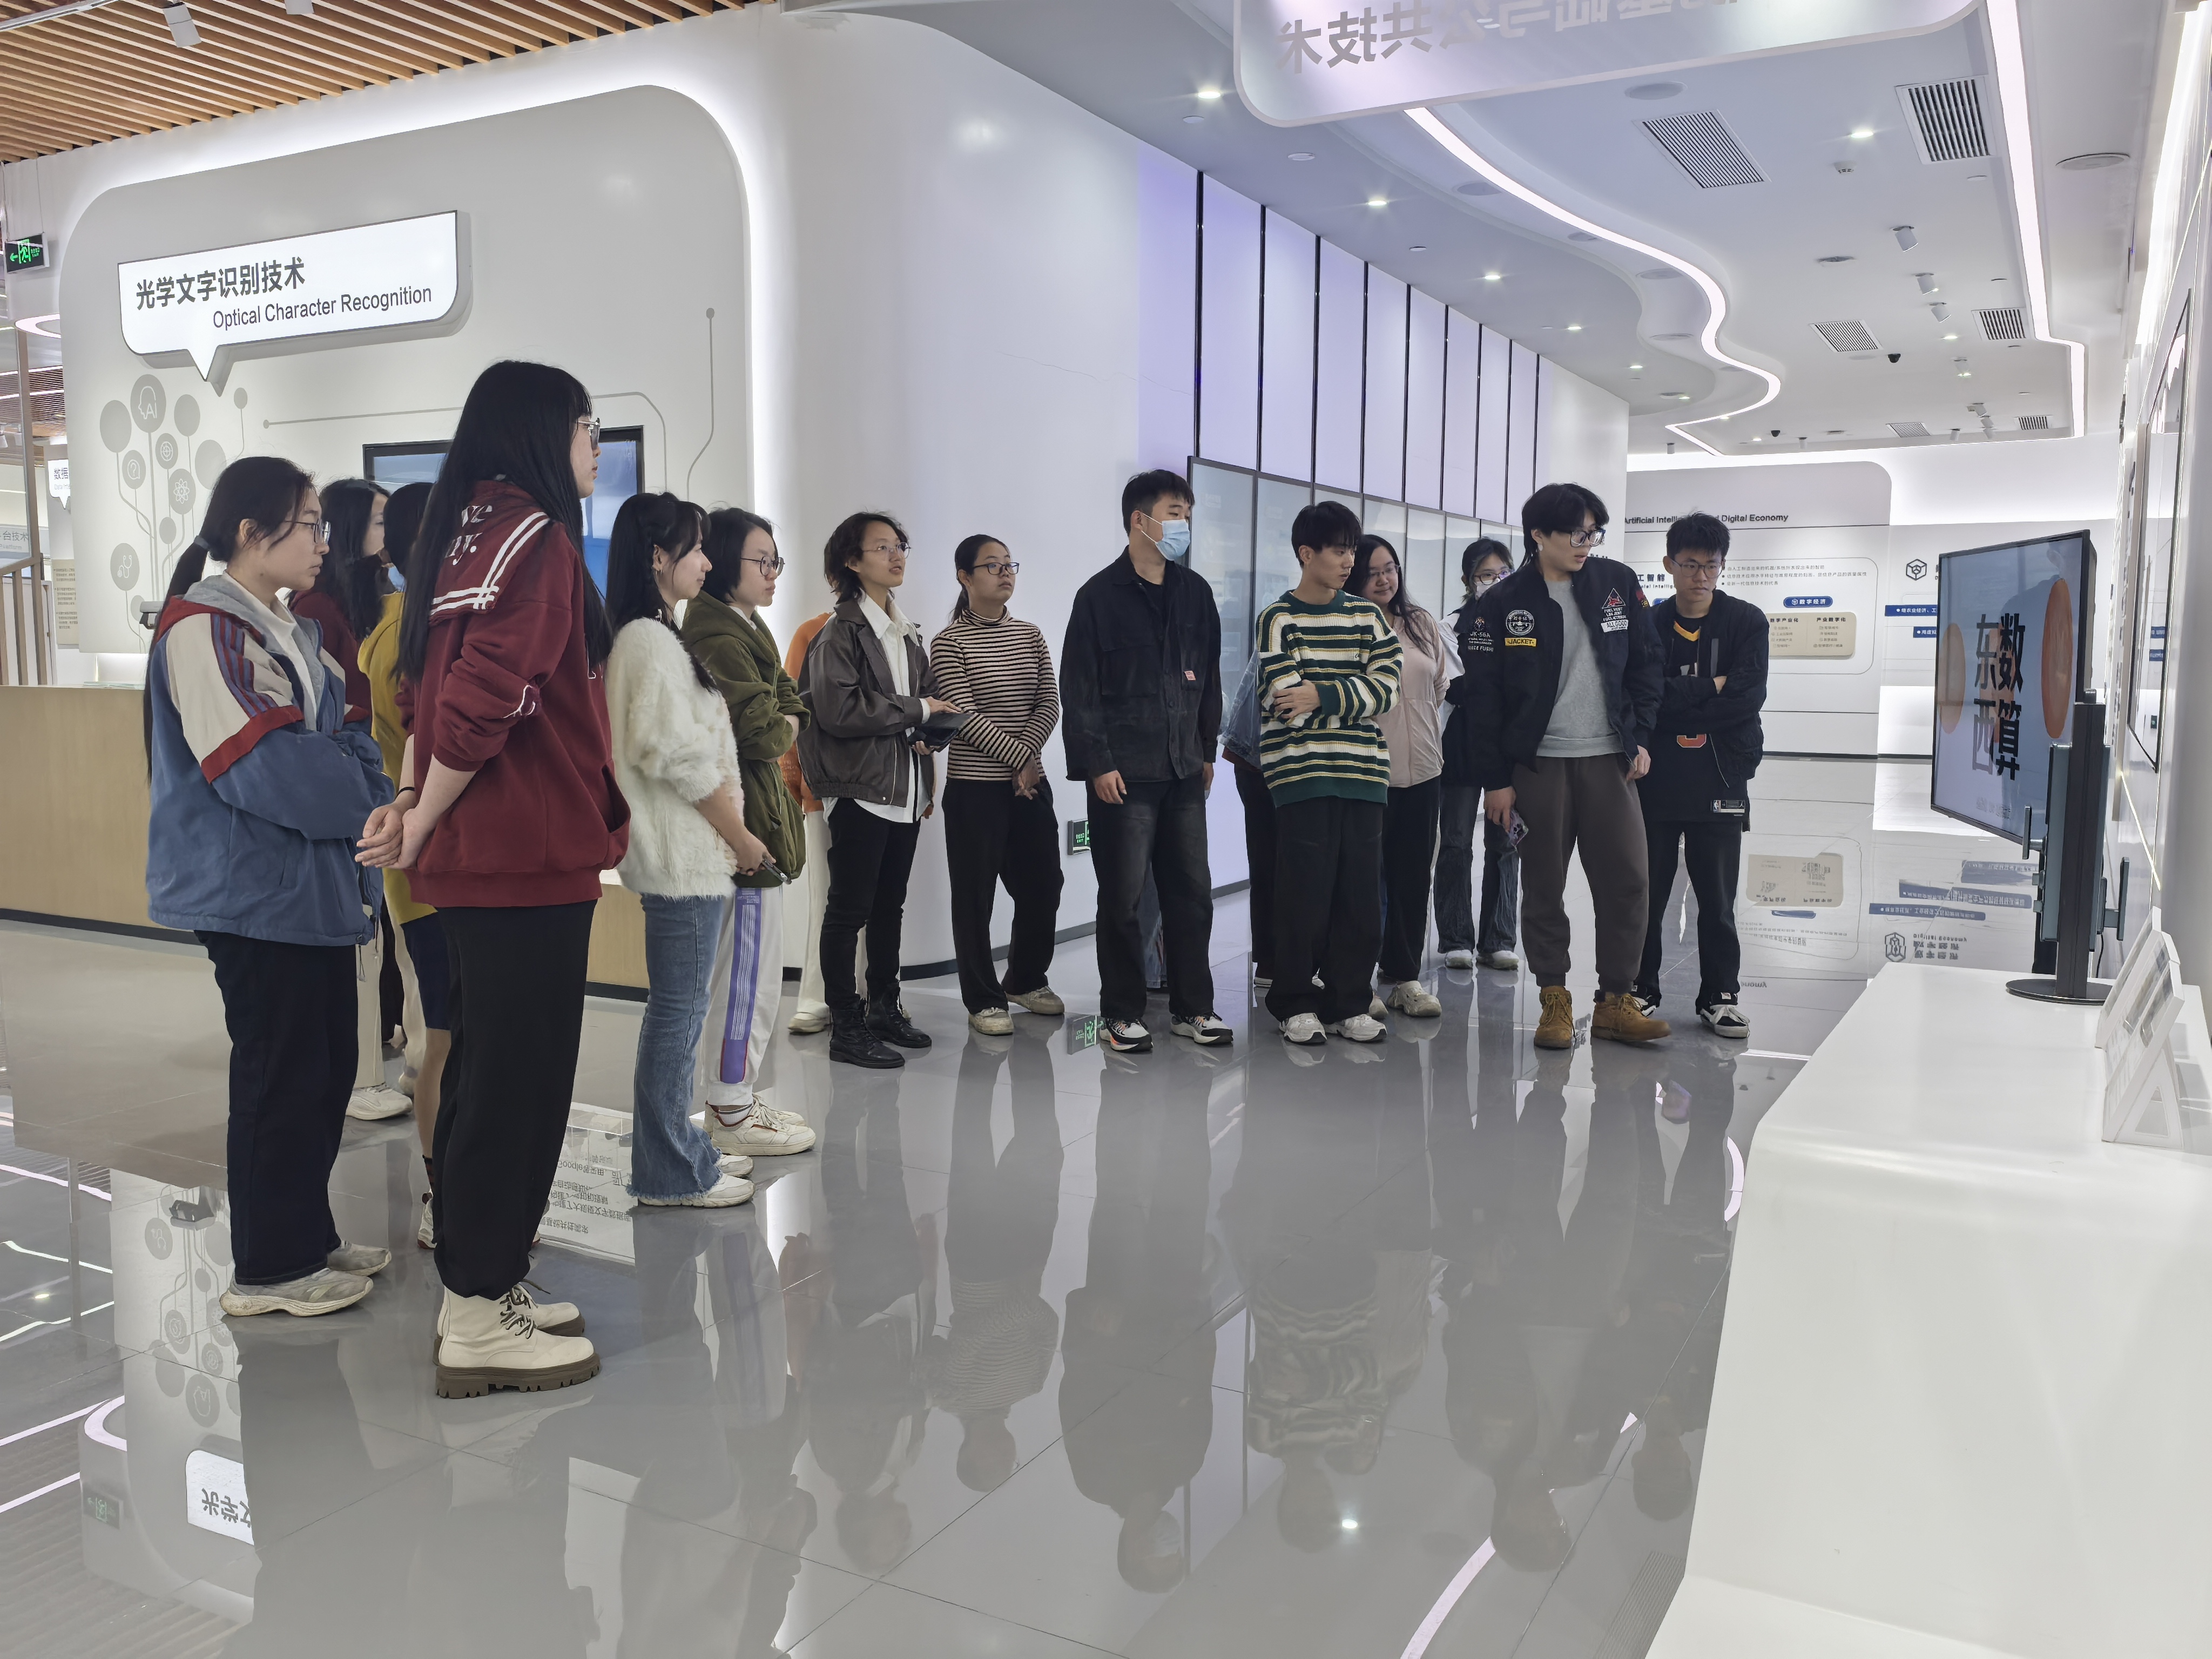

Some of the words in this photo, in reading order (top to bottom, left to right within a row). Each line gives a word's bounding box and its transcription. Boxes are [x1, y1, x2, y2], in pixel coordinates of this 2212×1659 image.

[136, 257, 305, 311] 光学文字识别技术
[213, 306, 261, 330] Optical
[265, 298, 336, 322] Character
[341, 286, 431, 312] Recognition
[0, 530, 28, 541] 台技术
[1637, 574, 1665, 582] 工智能
